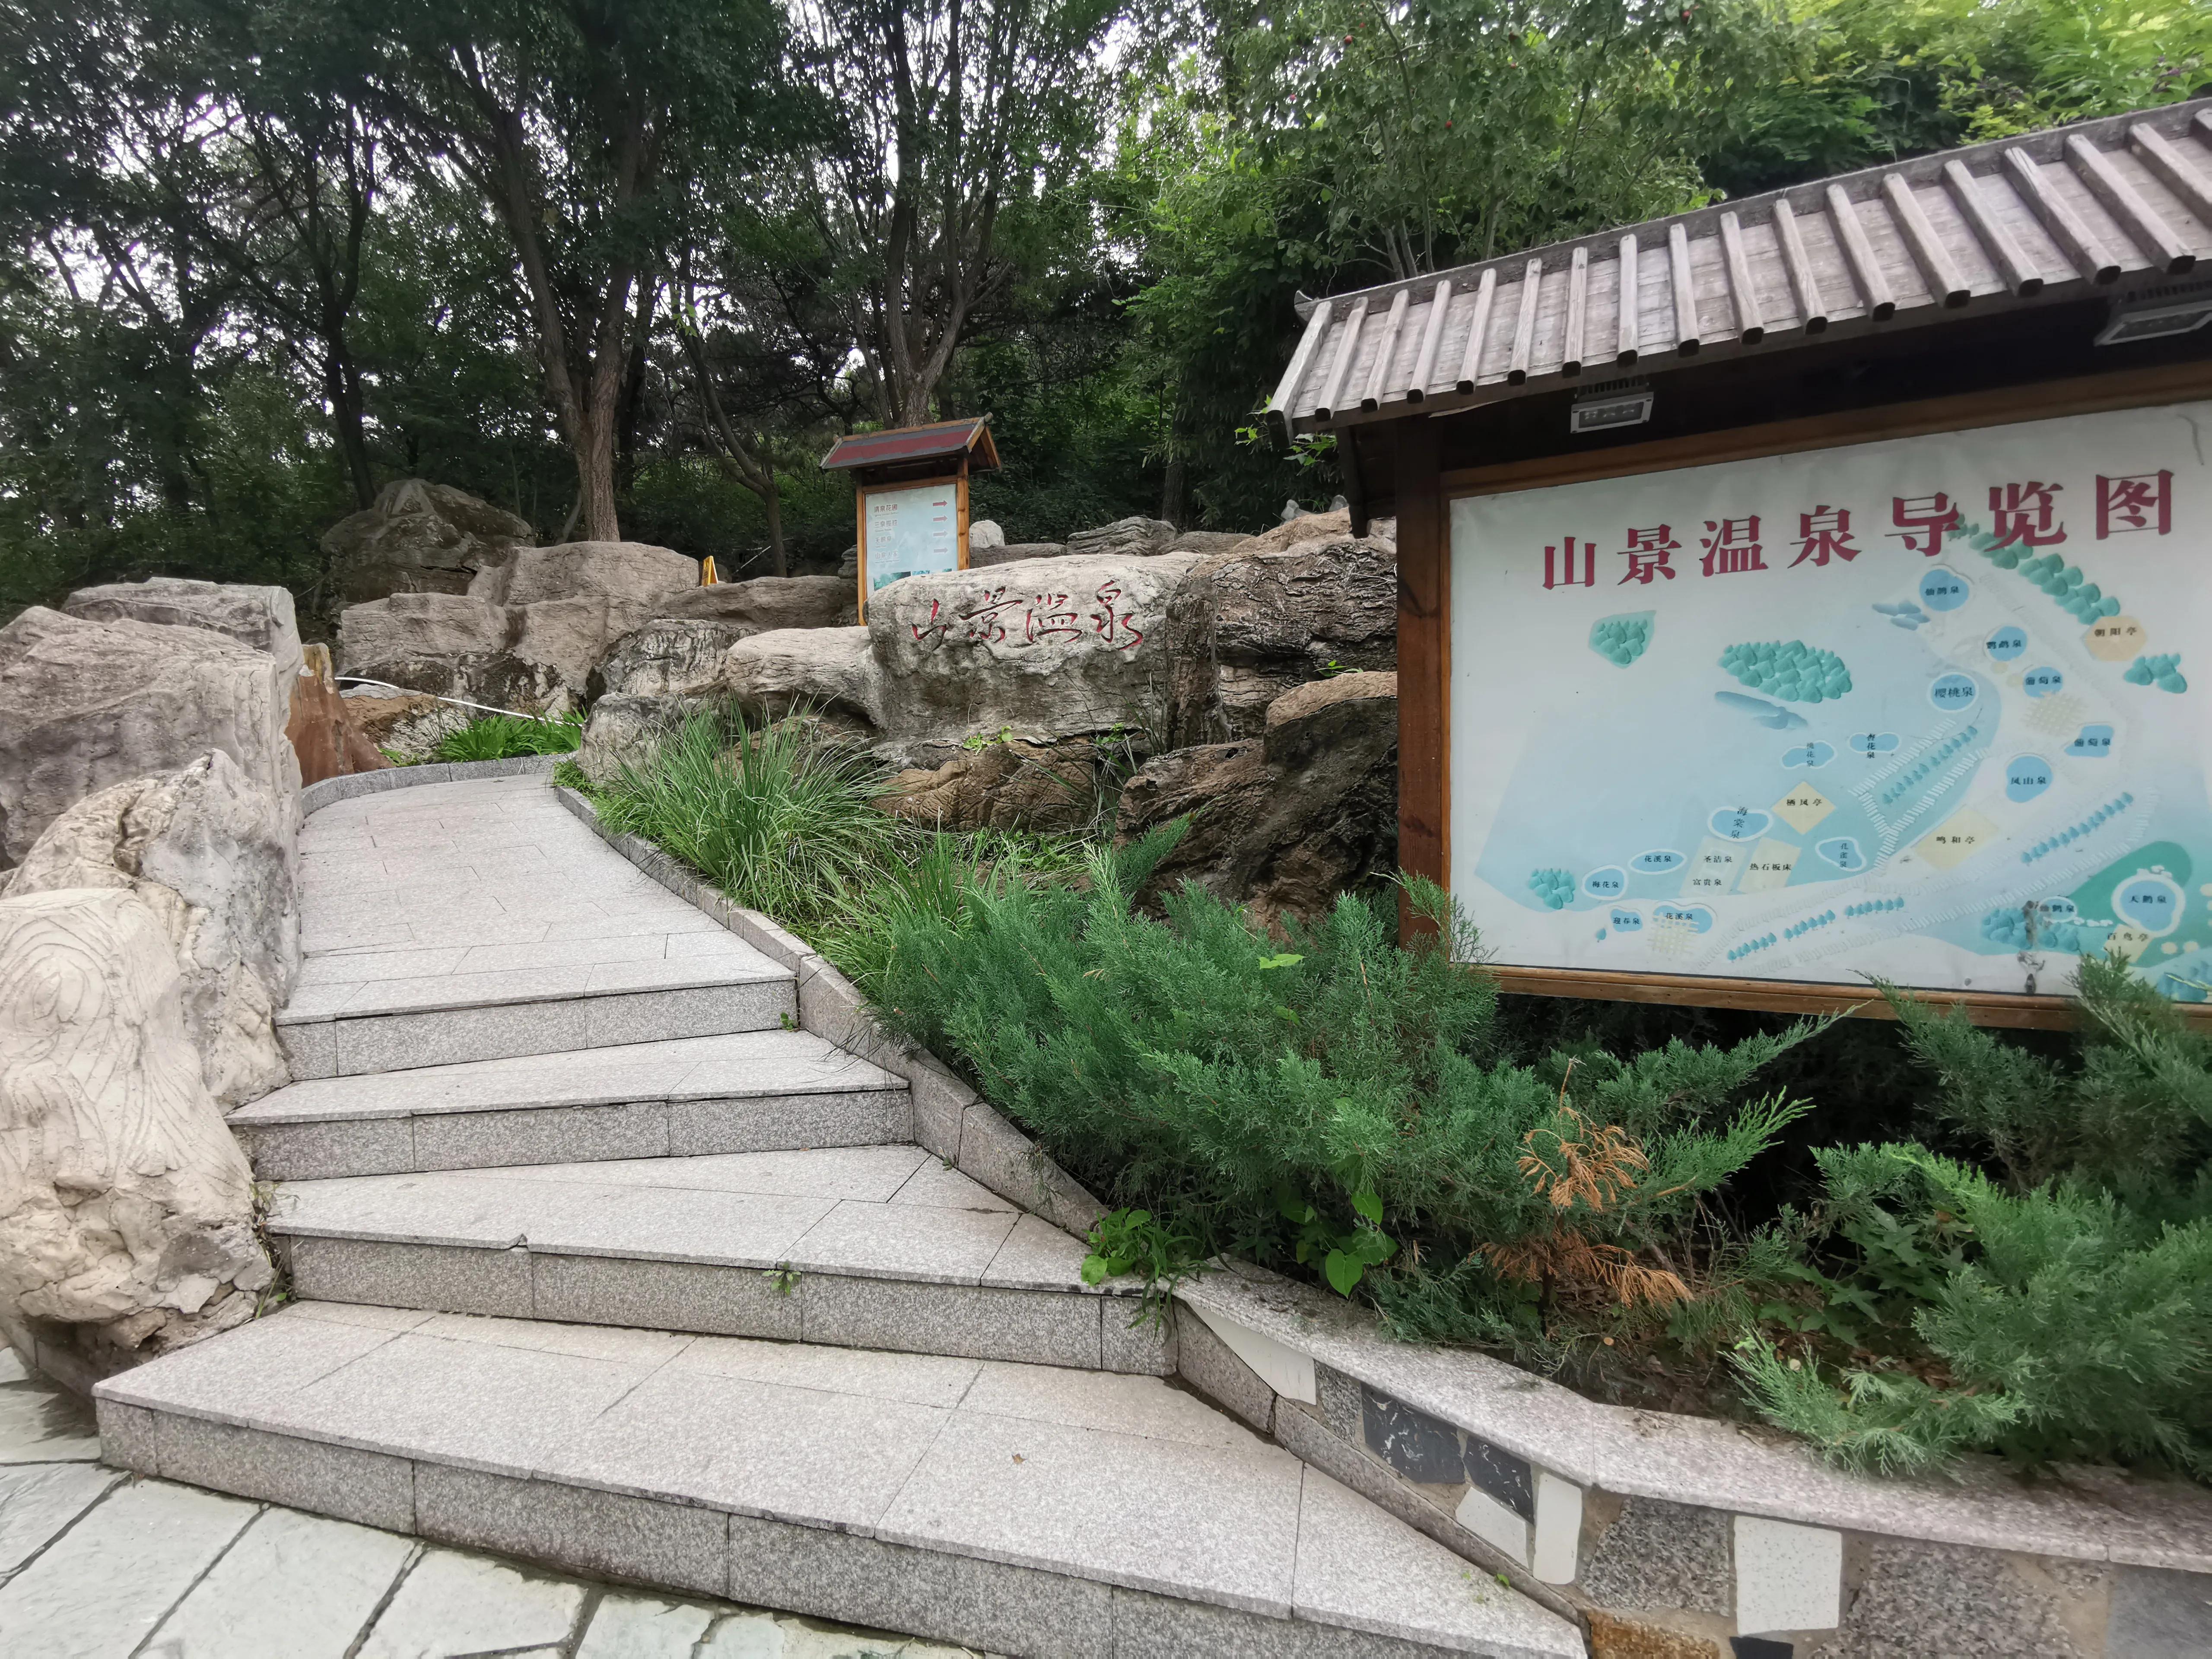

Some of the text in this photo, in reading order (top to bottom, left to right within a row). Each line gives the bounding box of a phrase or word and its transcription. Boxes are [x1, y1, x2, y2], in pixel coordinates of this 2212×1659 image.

[1542, 469, 2172, 590] 山景温泉导览图
[912, 580, 1143, 652] 山景温泉
[2094, 626, 2137, 637] 朝阳亭
[1934, 687, 1974, 698] 樱桃泉
